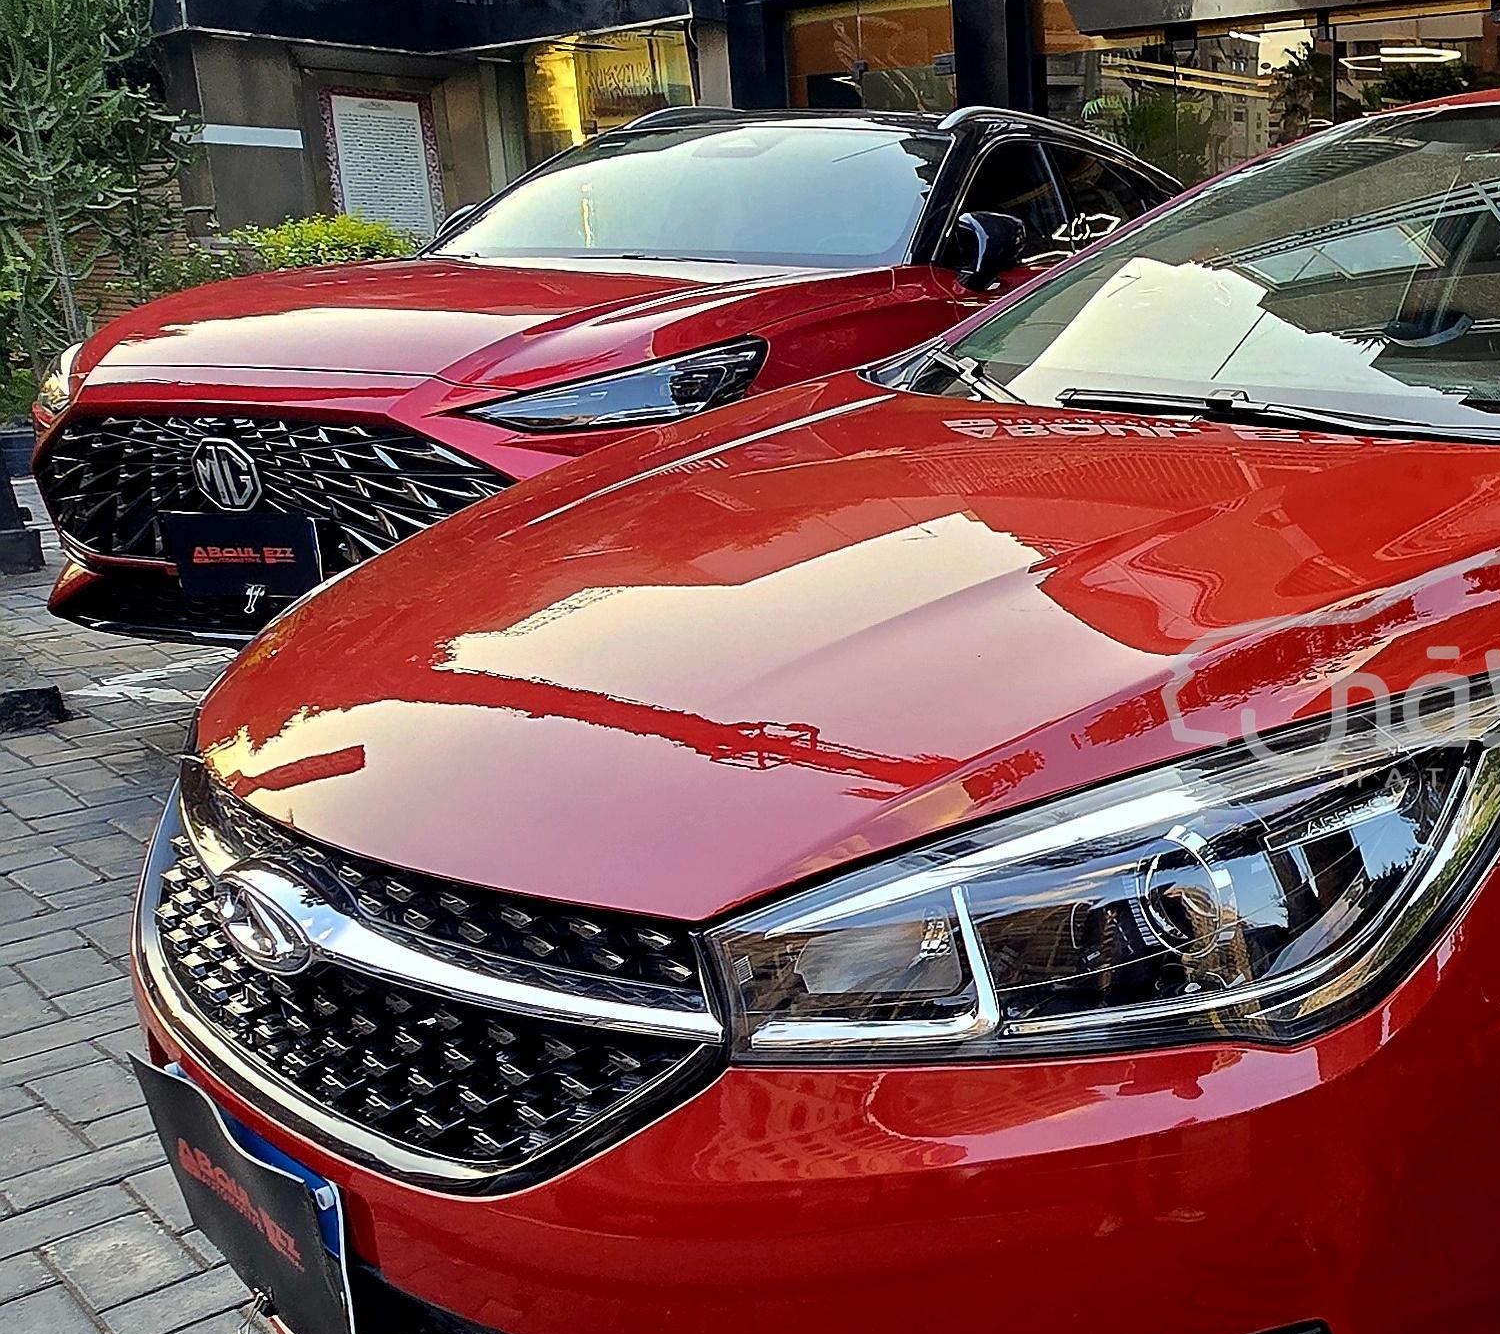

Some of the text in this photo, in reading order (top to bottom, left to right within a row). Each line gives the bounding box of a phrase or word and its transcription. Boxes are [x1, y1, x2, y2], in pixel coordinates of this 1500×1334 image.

[197, 446, 253, 505] MG
[193, 546, 295, 557] ABOUL EZZ
